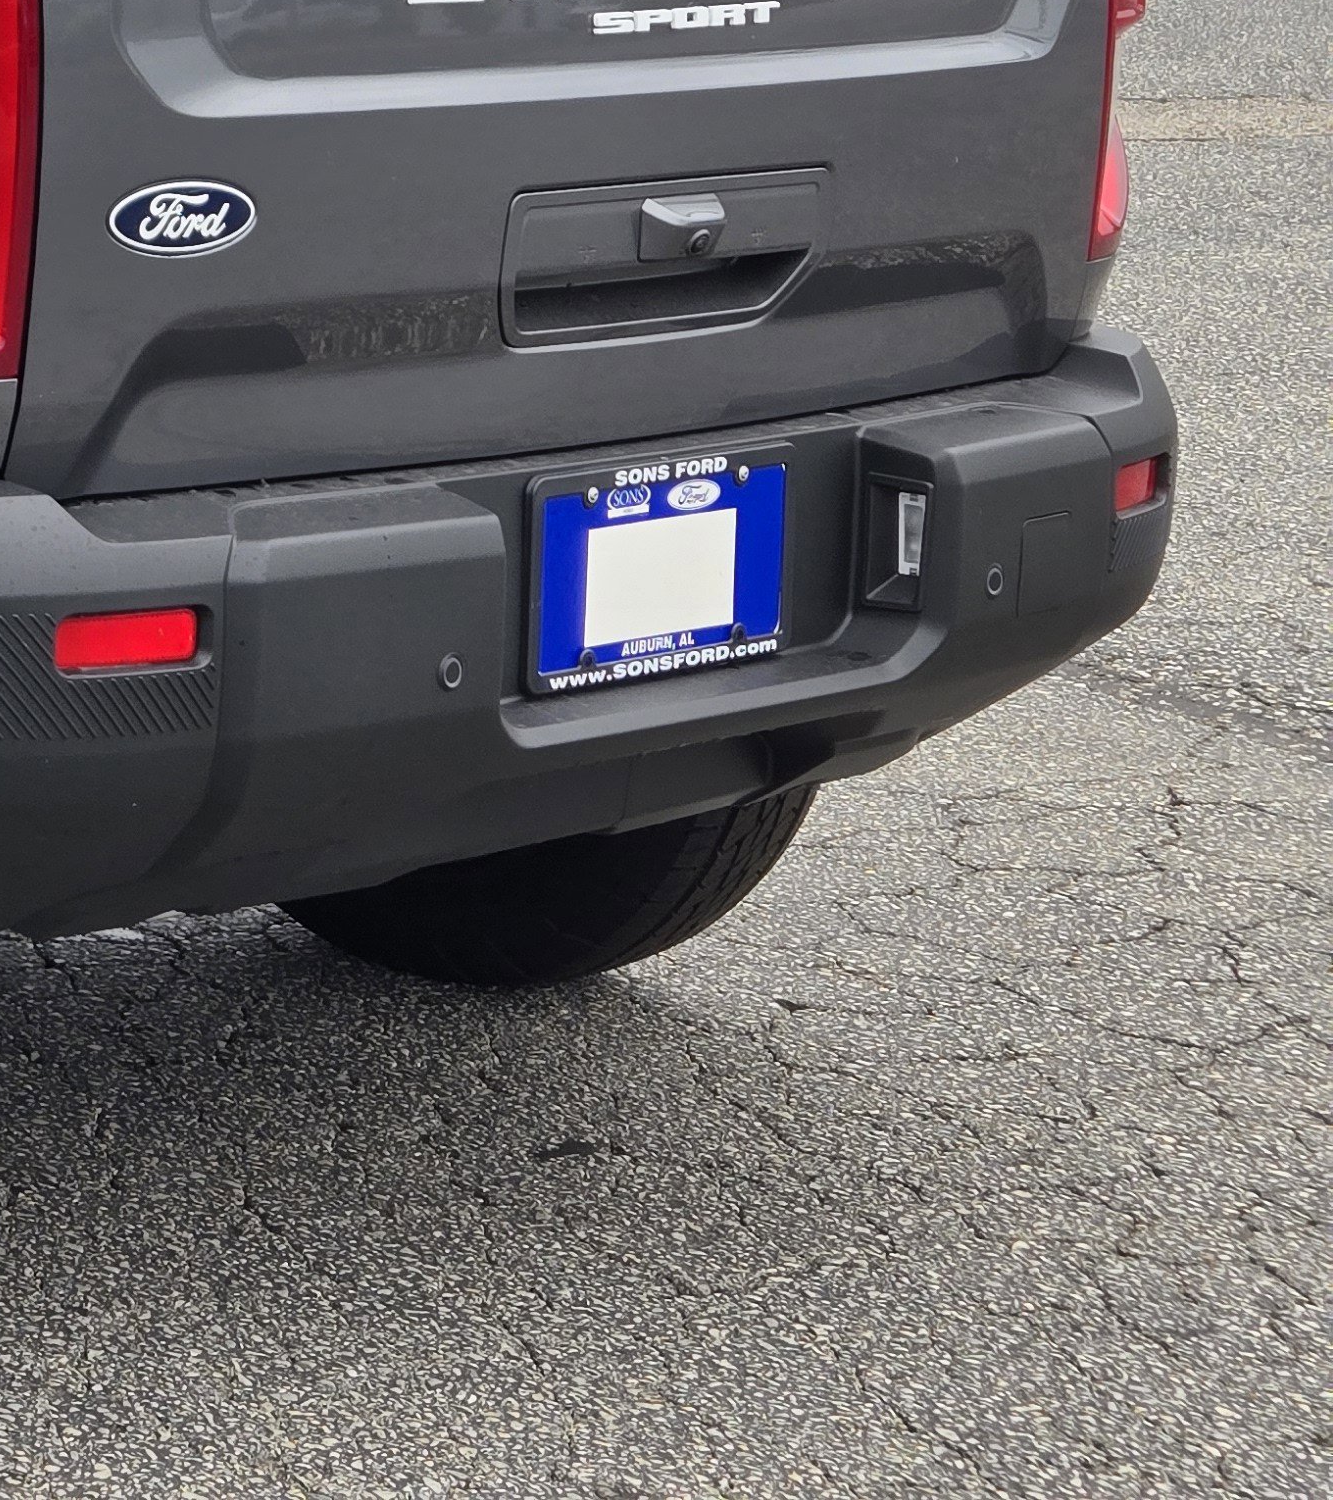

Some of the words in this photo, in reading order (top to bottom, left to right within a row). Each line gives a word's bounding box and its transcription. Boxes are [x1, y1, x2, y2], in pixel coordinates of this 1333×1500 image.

[592, 0, 781, 35] SPORT
[138, 192, 231, 241] Ford
[614, 463, 671, 488] SONS
[674, 456, 728, 480] FORD
[613, 486, 645, 507] SONS
[677, 484, 711, 506] Ford
[621, 636, 676, 658] AUBURN,
[678, 631, 695, 648] AL
[548, 638, 778, 691] www.SONSFORD.com
